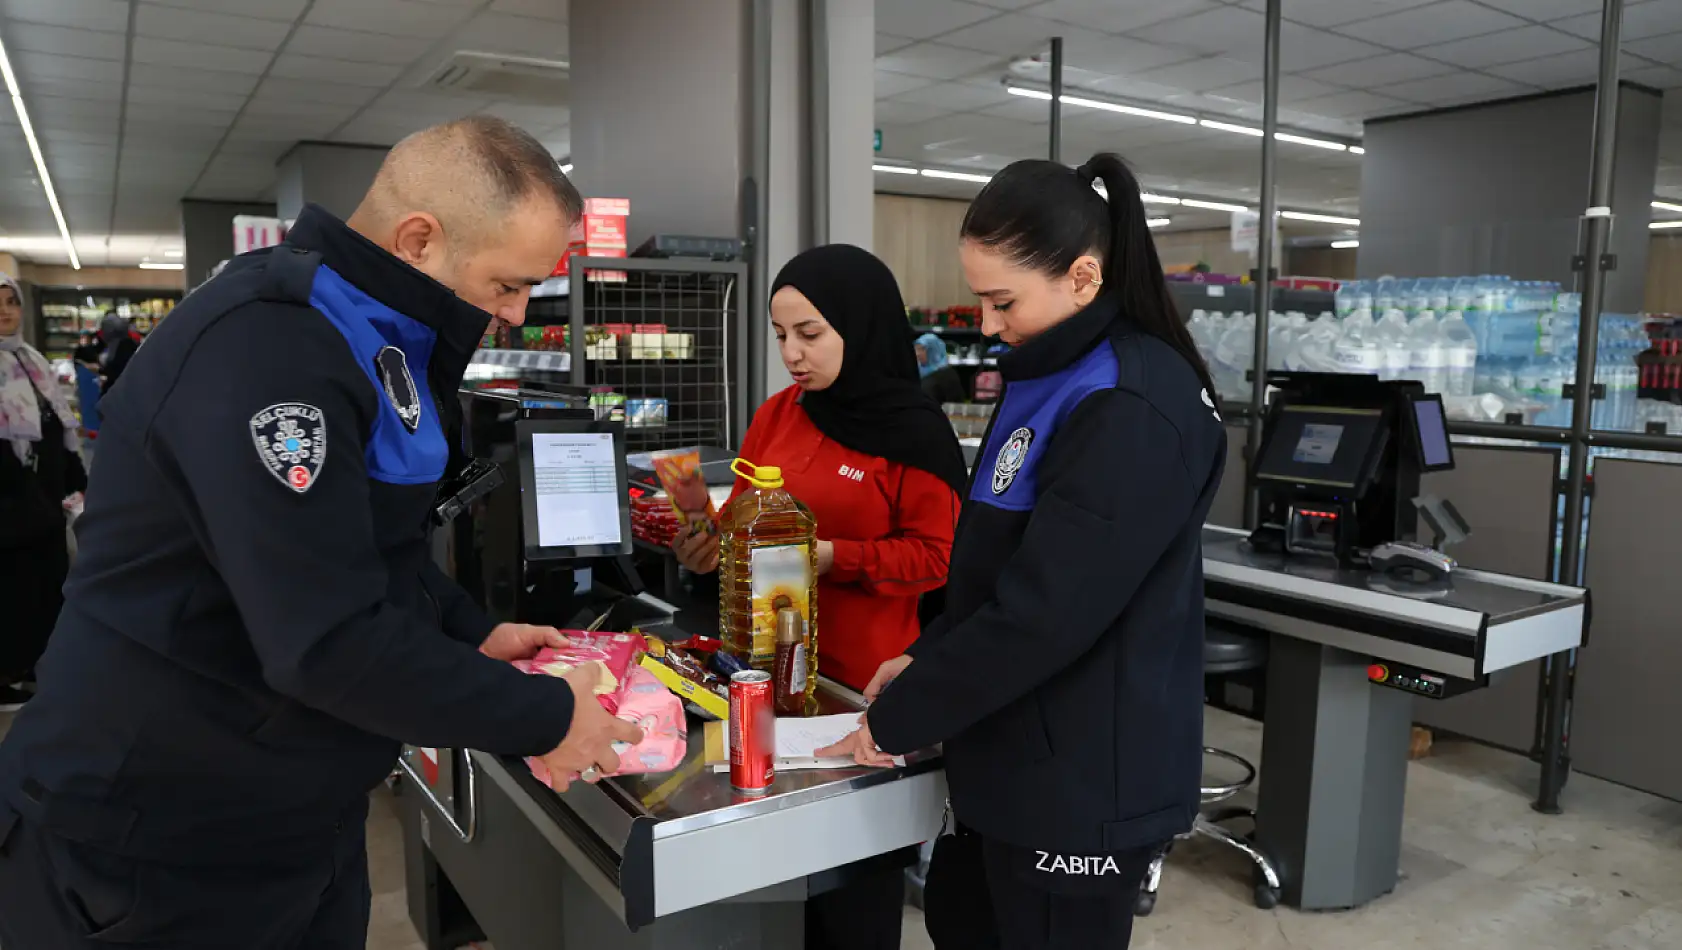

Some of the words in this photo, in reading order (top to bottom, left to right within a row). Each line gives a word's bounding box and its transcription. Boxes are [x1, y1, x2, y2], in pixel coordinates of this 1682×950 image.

[251, 405, 320, 428] SELÇUKLU
[838, 464, 865, 482] BIM
[1036, 850, 1121, 875] ZABITA
